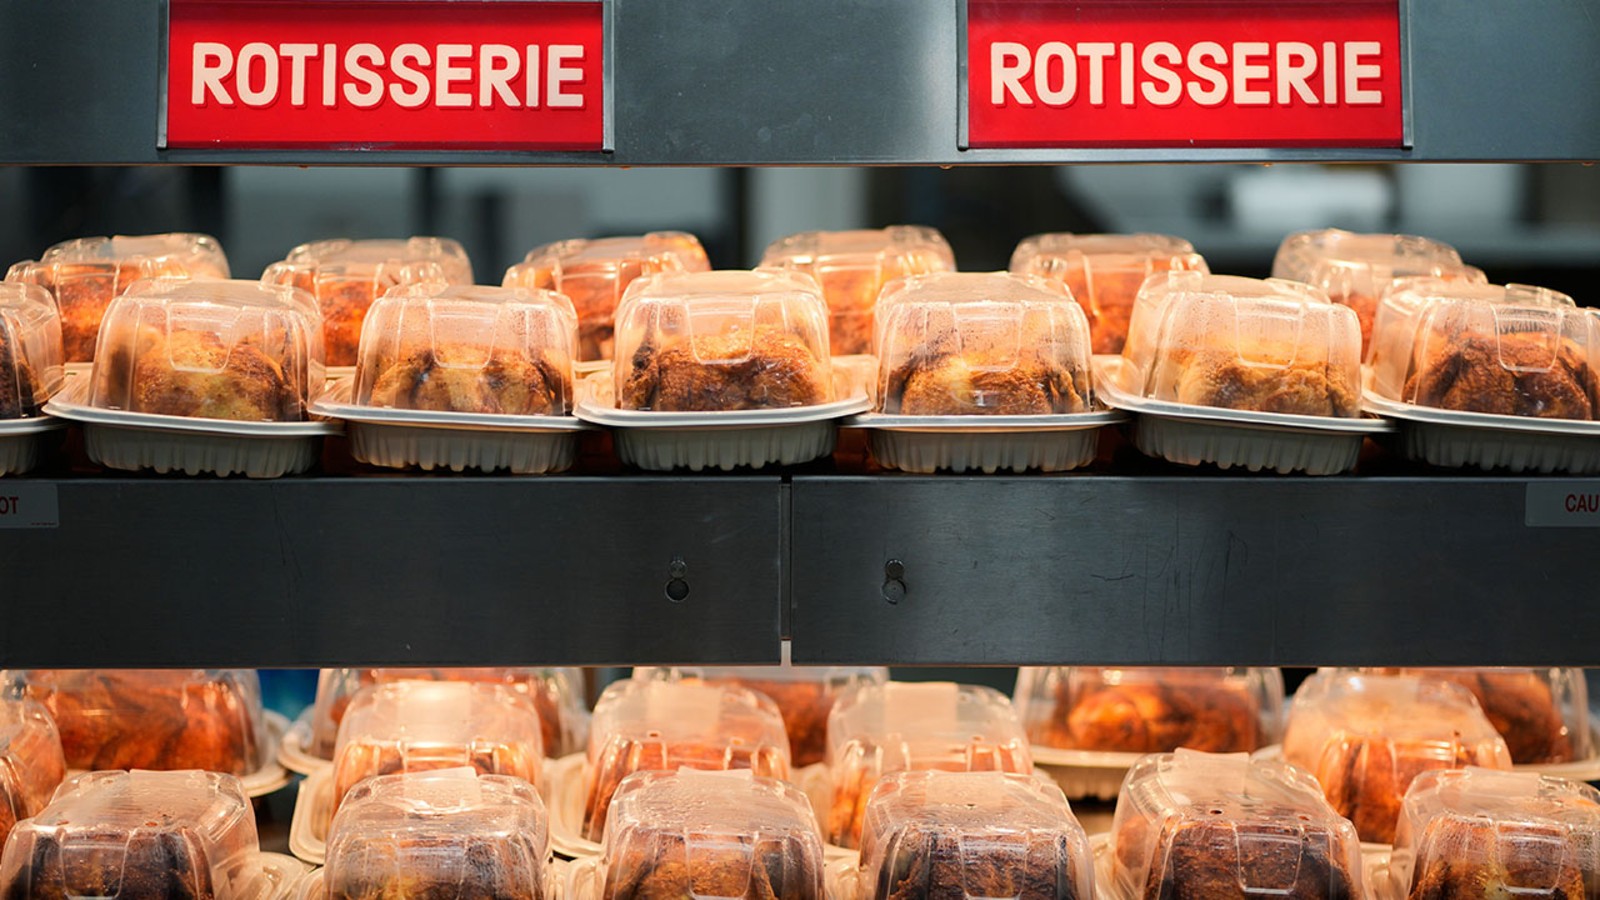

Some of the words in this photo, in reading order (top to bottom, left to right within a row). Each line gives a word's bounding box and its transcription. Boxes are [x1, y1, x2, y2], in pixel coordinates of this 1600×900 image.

[191, 42, 584, 107] ROTISSERIE
[990, 41, 1382, 105] ROTISSERIE
[1565, 494, 1600, 512] CAU
